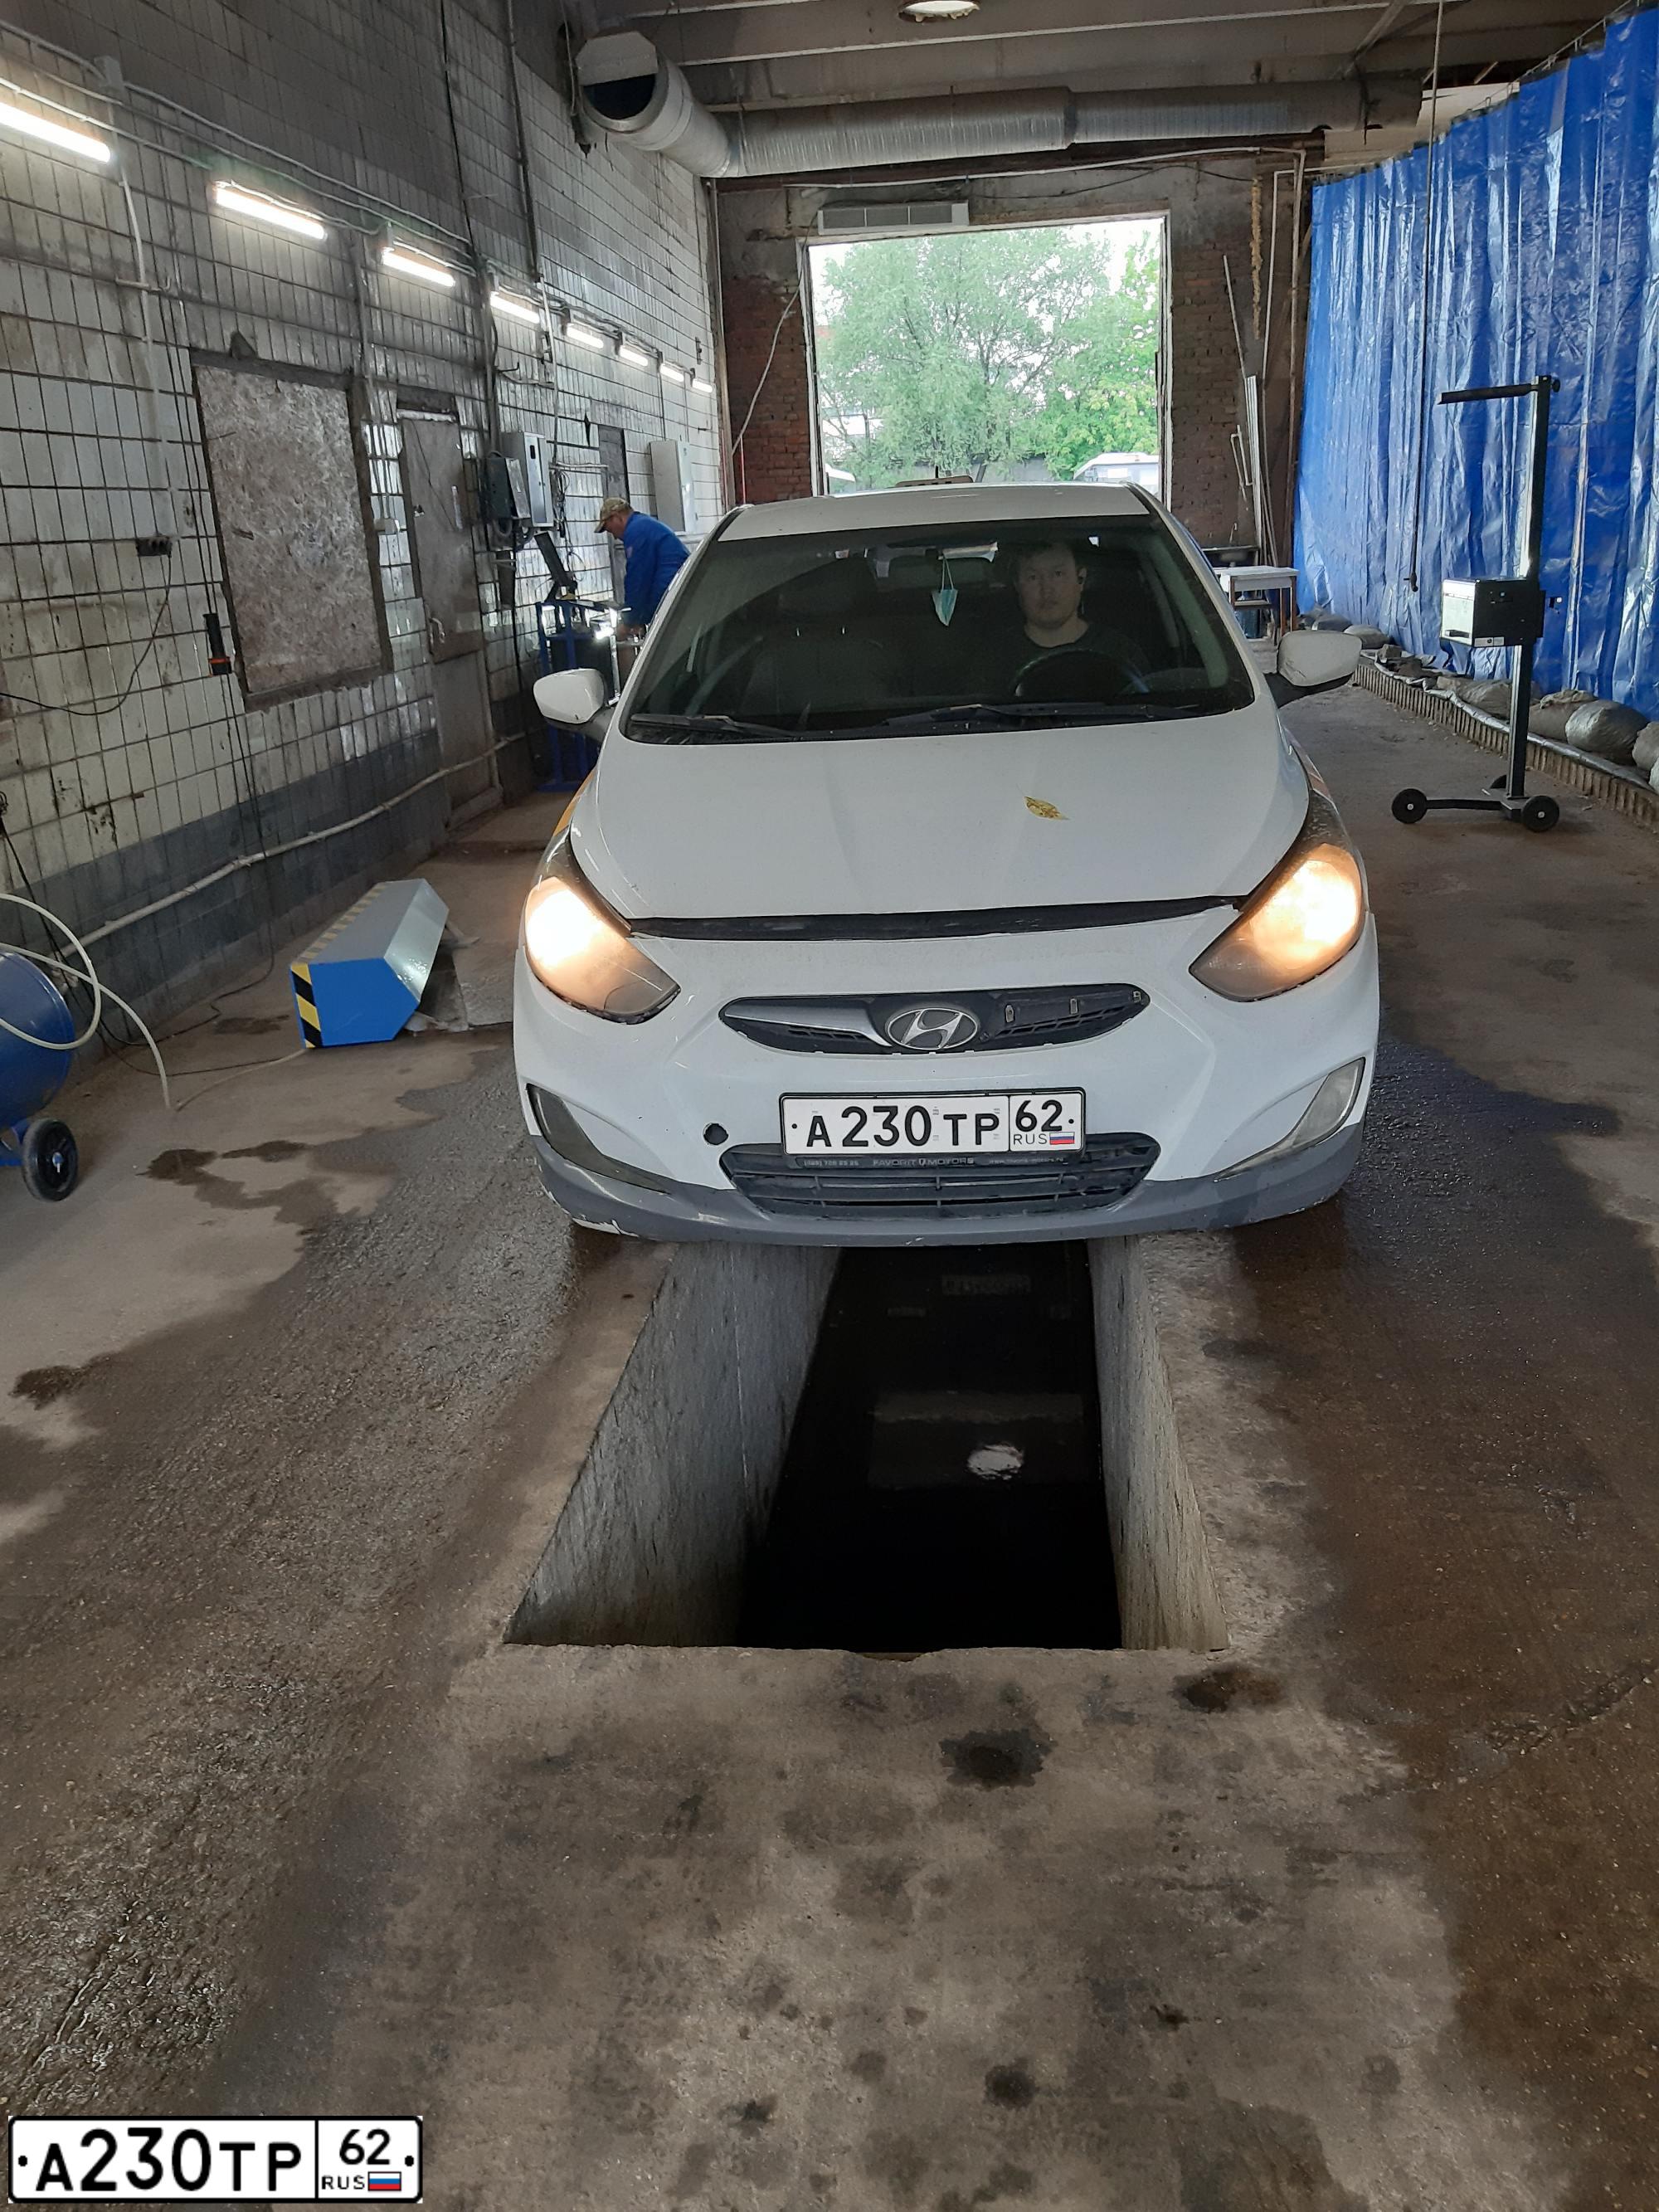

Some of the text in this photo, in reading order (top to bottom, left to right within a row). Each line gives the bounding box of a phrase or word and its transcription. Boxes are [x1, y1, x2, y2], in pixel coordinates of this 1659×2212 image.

[1014, 1099, 1063, 1132] 62
[1013, 1133, 1048, 1145] RUS
[927, 1157, 975, 1166] MOTORS
